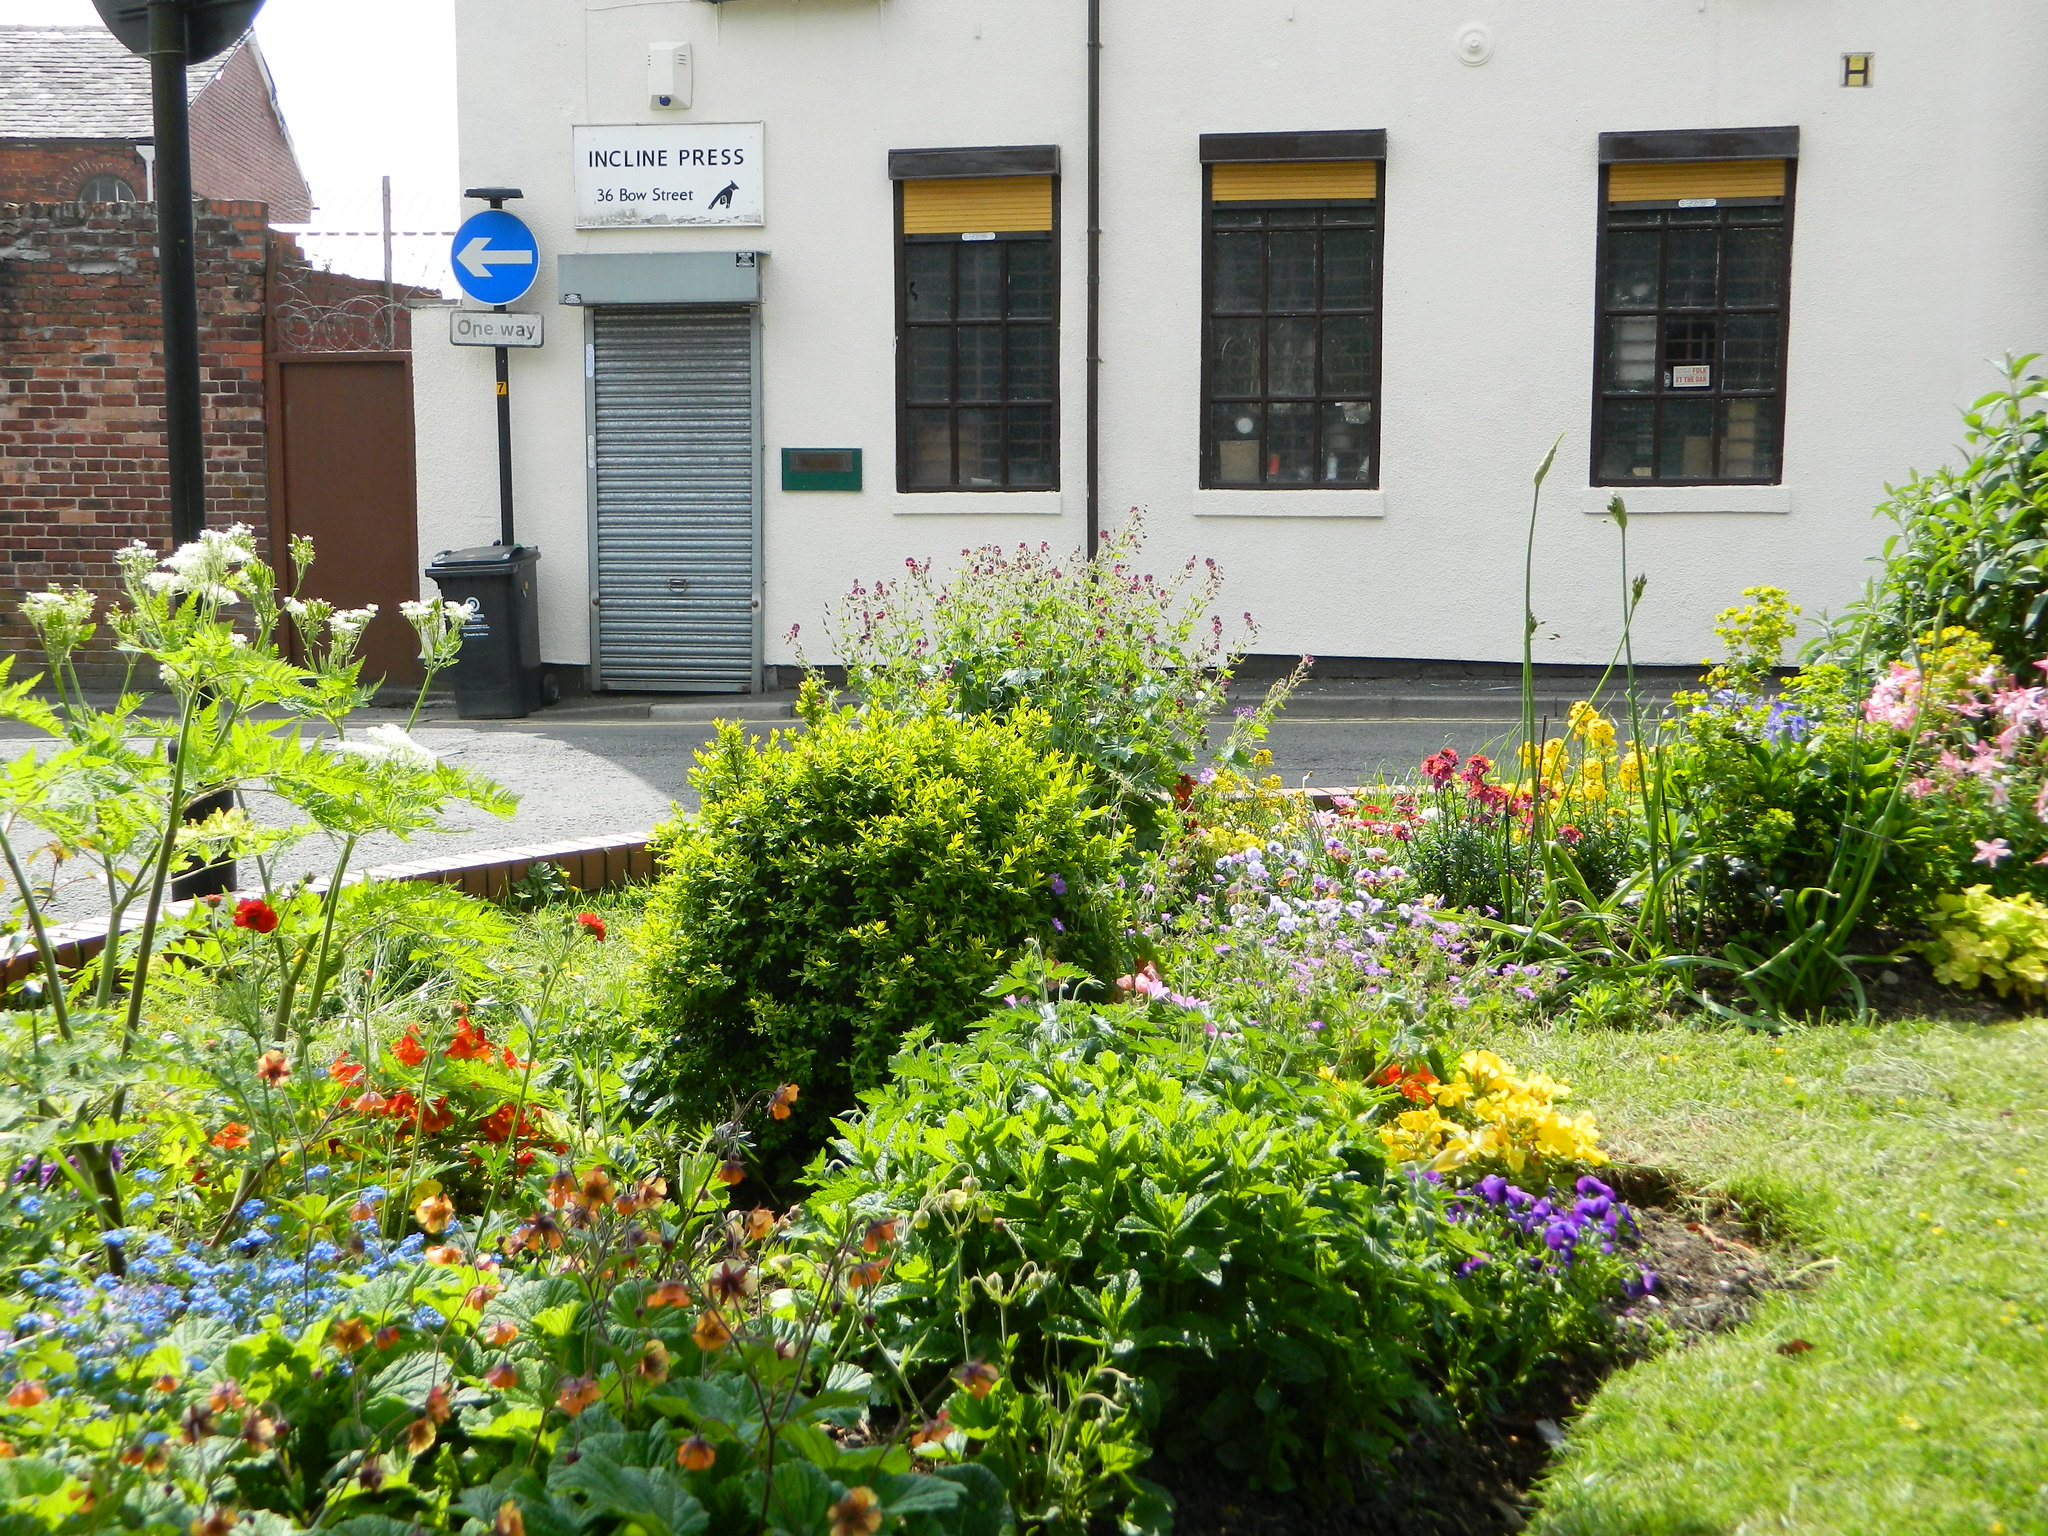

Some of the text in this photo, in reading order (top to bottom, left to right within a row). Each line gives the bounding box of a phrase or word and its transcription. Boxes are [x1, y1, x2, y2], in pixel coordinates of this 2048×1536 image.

[1845, 55, 1868, 86] H
[588, 148, 744, 167] INCLINE PRESS
[597, 187, 694, 202] 36 Bow Street
[457, 319, 536, 339] One way
[497, 382, 505, 393] 7
